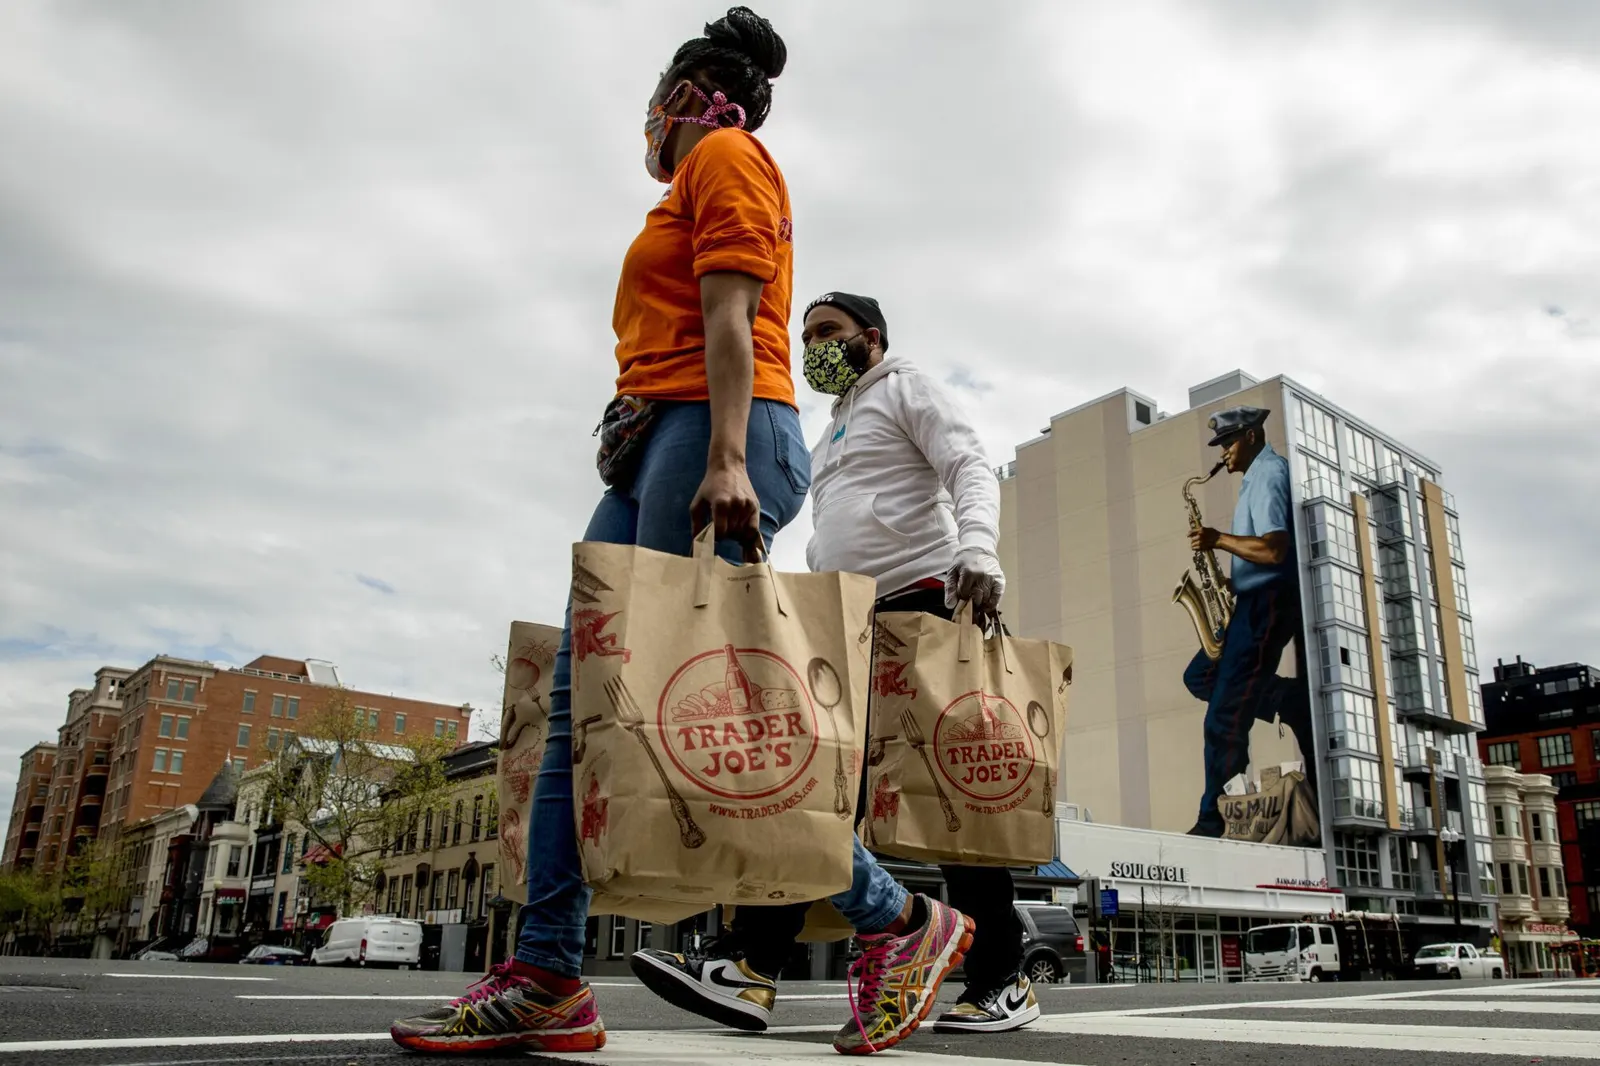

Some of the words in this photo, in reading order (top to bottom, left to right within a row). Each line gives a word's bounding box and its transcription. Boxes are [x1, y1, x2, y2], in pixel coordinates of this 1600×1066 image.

[677, 712, 807, 751] TRADER
[701, 742, 793, 777] JOE'S
[947, 741, 1028, 765] TRADER
[961, 762, 1020, 784] JOE'S
[1225, 801, 1244, 820] US
[1246, 796, 1281, 819] MAIL
